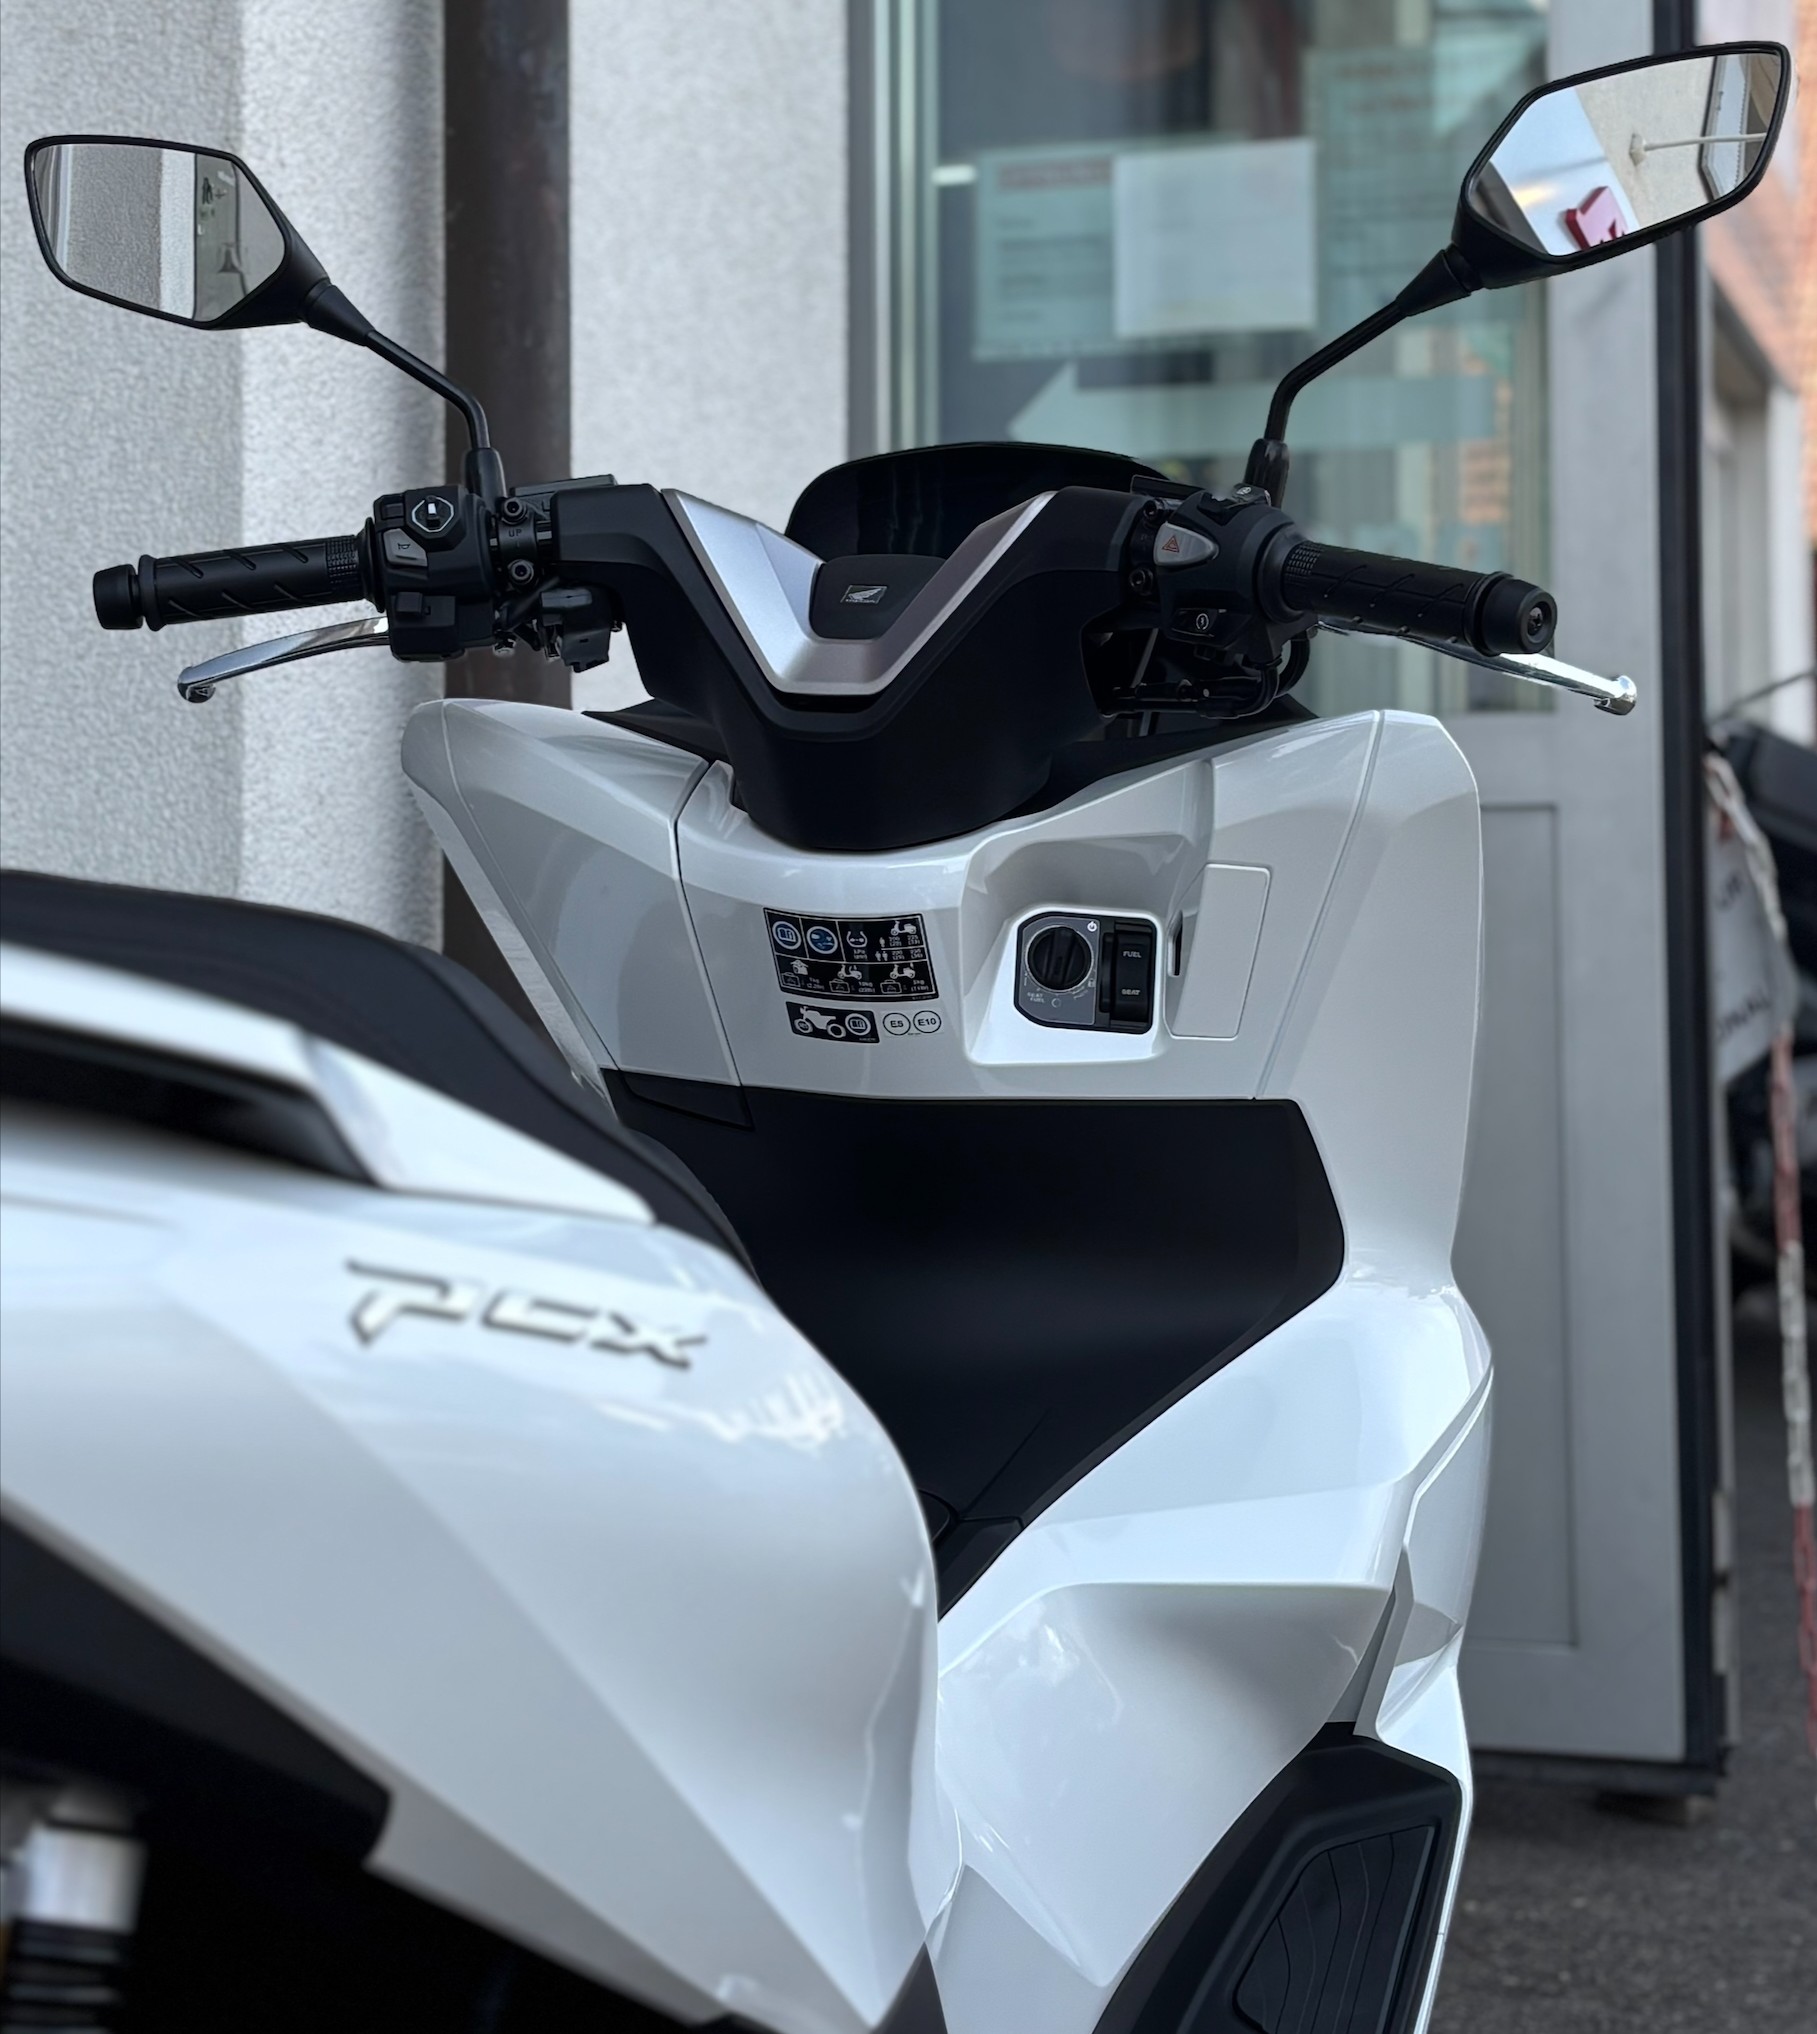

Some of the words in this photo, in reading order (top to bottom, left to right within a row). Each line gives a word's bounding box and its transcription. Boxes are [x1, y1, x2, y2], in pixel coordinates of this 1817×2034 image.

[508, 529, 522, 537] UP
[890, 1020, 904, 1028] E5
[918, 1018, 937, 1026] E10
[344, 1258, 708, 1371] PCX
